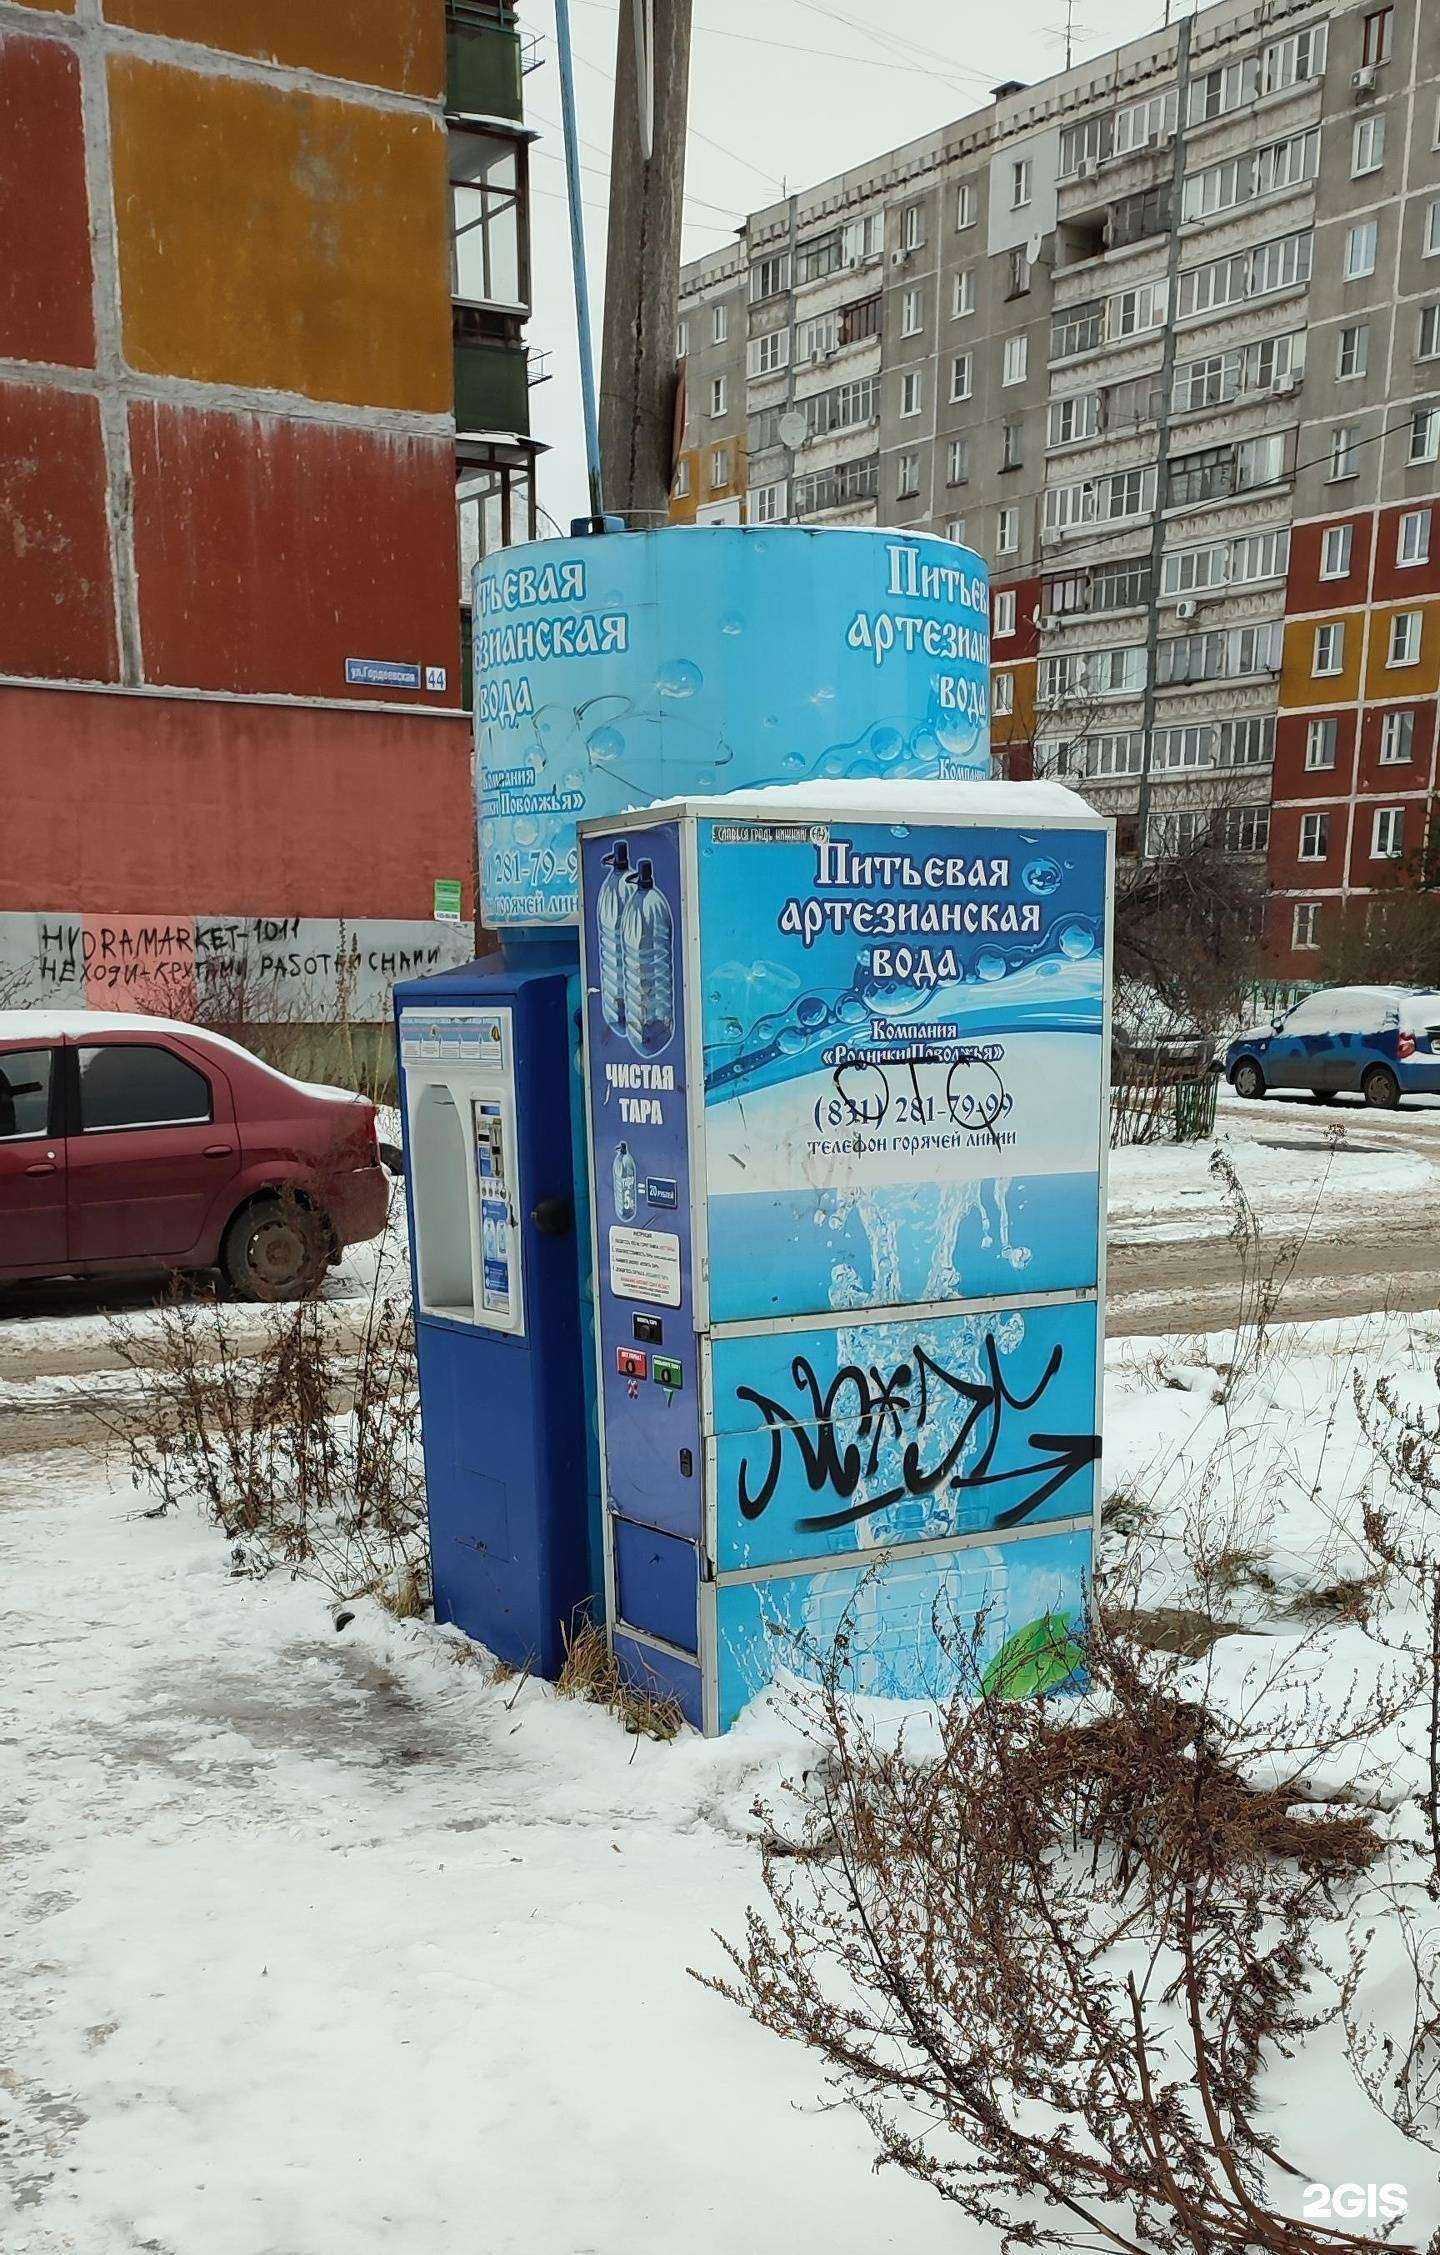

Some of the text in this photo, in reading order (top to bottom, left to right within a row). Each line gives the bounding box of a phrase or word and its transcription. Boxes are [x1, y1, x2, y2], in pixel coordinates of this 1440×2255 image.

[885, 545, 988, 616] Питьев
[848, 612, 990, 667] артезиан
[428, 669, 445, 688] 44
[480, 678, 534, 728] вода
[940, 676, 986, 725] вода
[816, 841, 1010, 888] Питьевая
[780, 900, 1041, 945] артезианская
[872, 947, 958, 986] вода
[872, 1020, 958, 1040] Компания
[605, 1063, 675, 1091] ЧИСТАЯ
[618, 1098, 664, 1125] ТАРА
[807, 1130, 1017, 1160] телефон горячей линии
